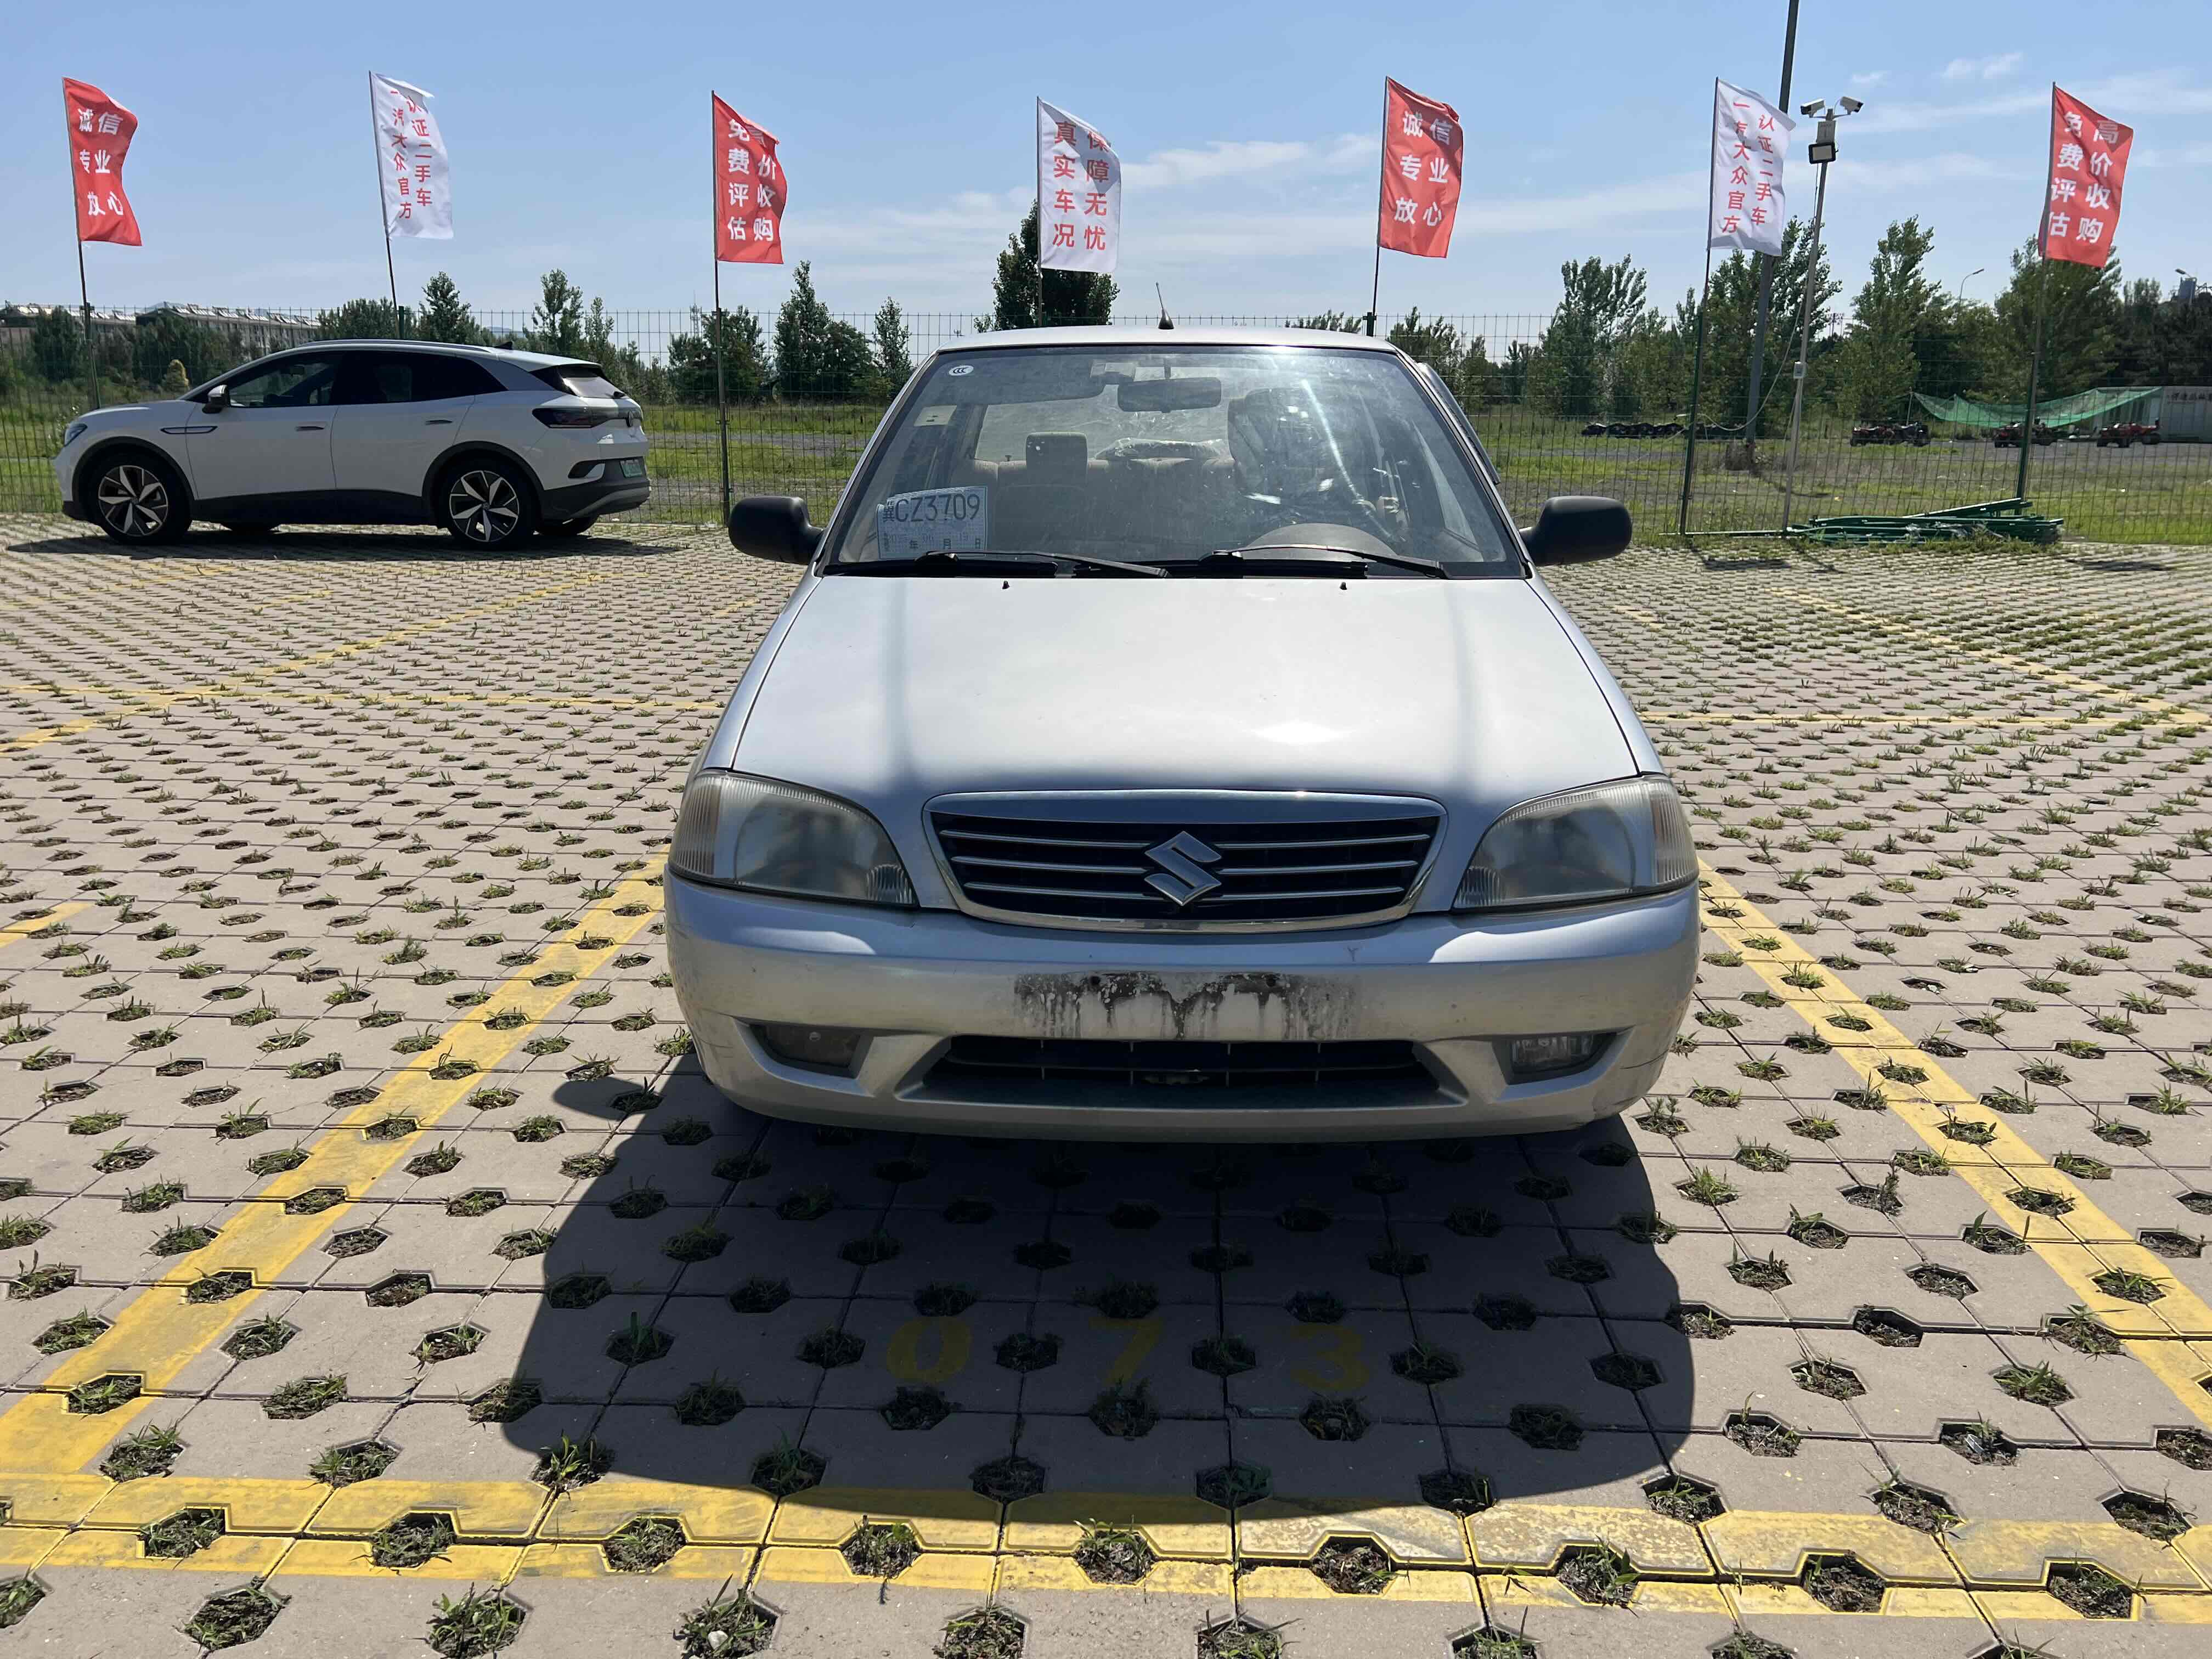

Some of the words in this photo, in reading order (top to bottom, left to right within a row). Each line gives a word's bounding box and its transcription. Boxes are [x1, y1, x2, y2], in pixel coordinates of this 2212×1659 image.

[78, 109, 123, 136] 诚信
[407, 95, 432, 206] 认证二手车
[1403, 111, 1453, 145] 诚信
[80, 149, 111, 173] 专业
[727, 119, 749, 240] 免费评估
[1052, 121, 1076, 248] 真实车况
[1400, 154, 1449, 183] 专业
[1751, 114, 1774, 225] 认证二手车
[2048, 111, 2084, 237] 免费评估
[2076, 119, 2119, 243] 高价收购
[87, 191, 123, 216] 放心
[1393, 197, 1442, 227] 放心
